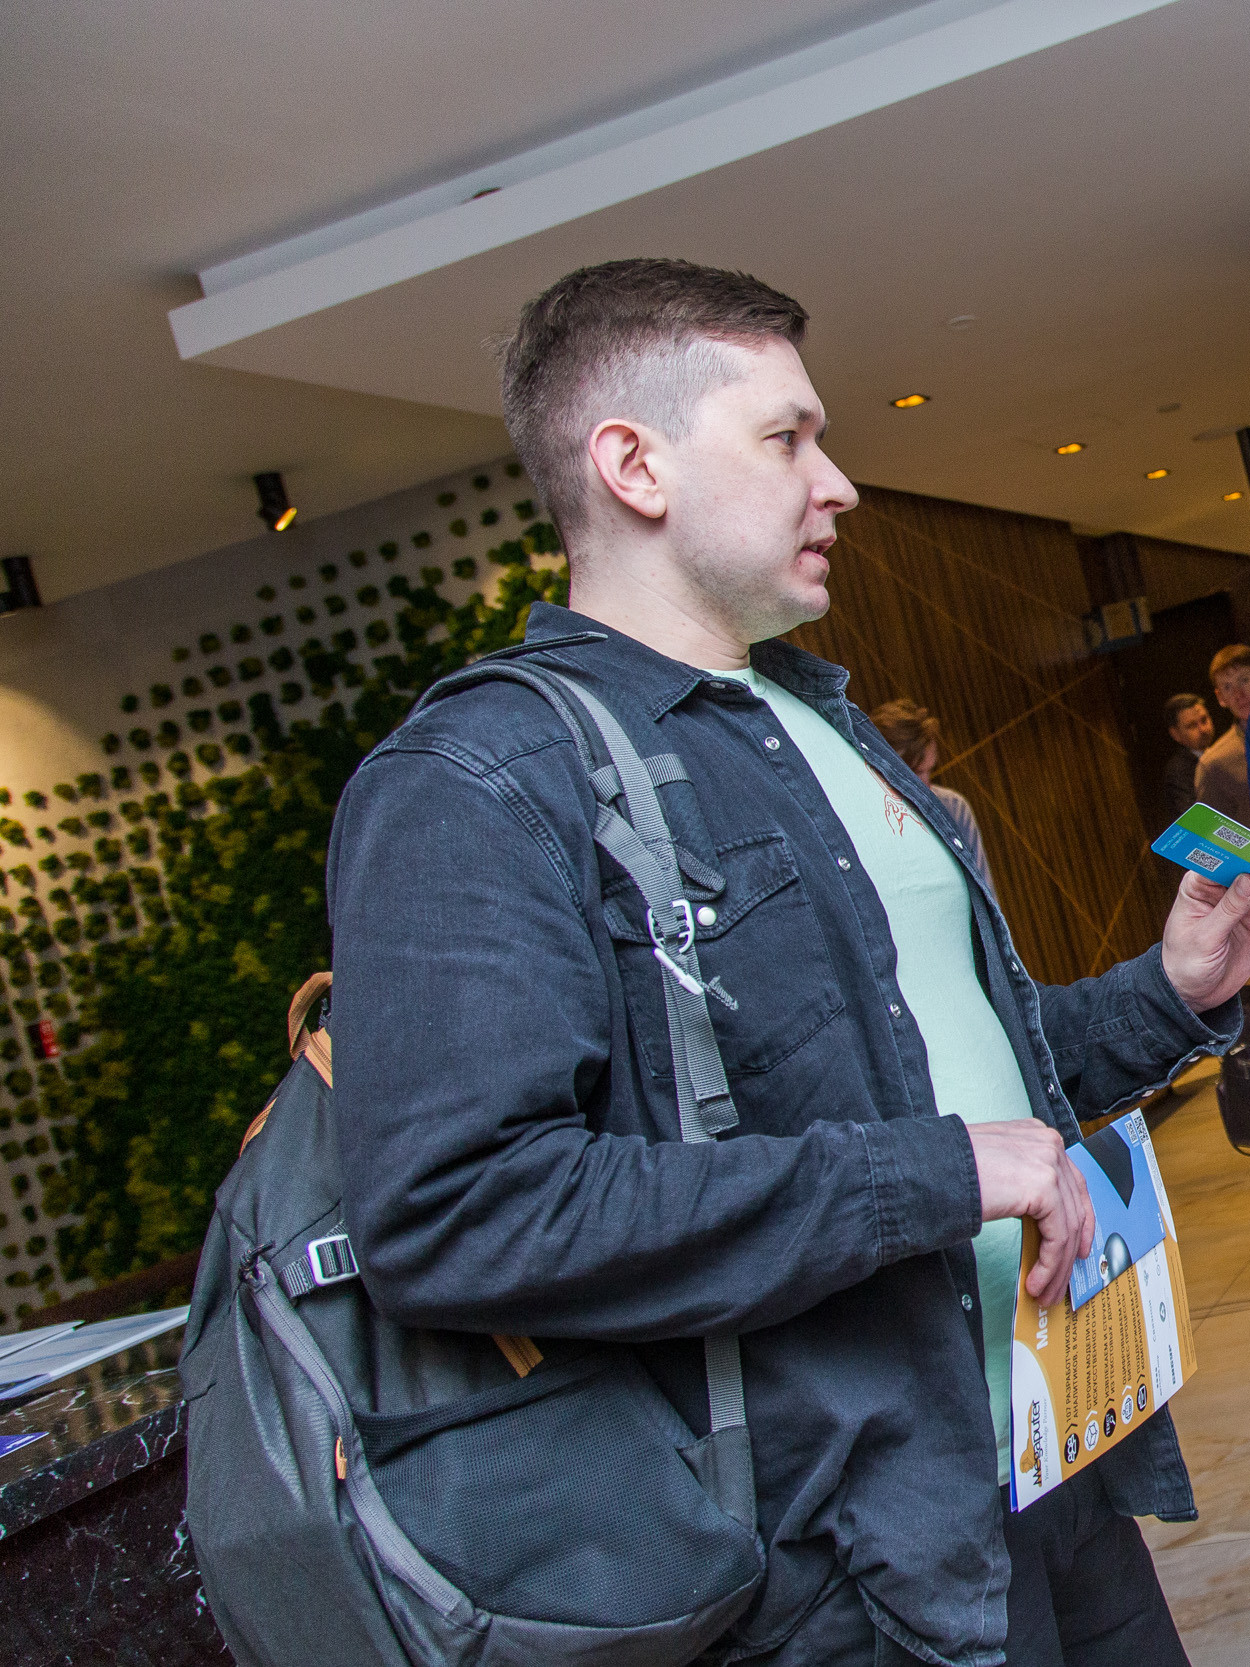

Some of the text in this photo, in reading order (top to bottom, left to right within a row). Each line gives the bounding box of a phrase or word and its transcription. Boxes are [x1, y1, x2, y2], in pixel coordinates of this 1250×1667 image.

[1086, 1313, 1090, 1325] НА
[1122, 1293, 1130, 1381] БИЗНЕС-ПРОЦЕССЫ
[1110, 1380, 1114, 1392] ИЗ
[1032, 1399, 1044, 1488] Megaputer
